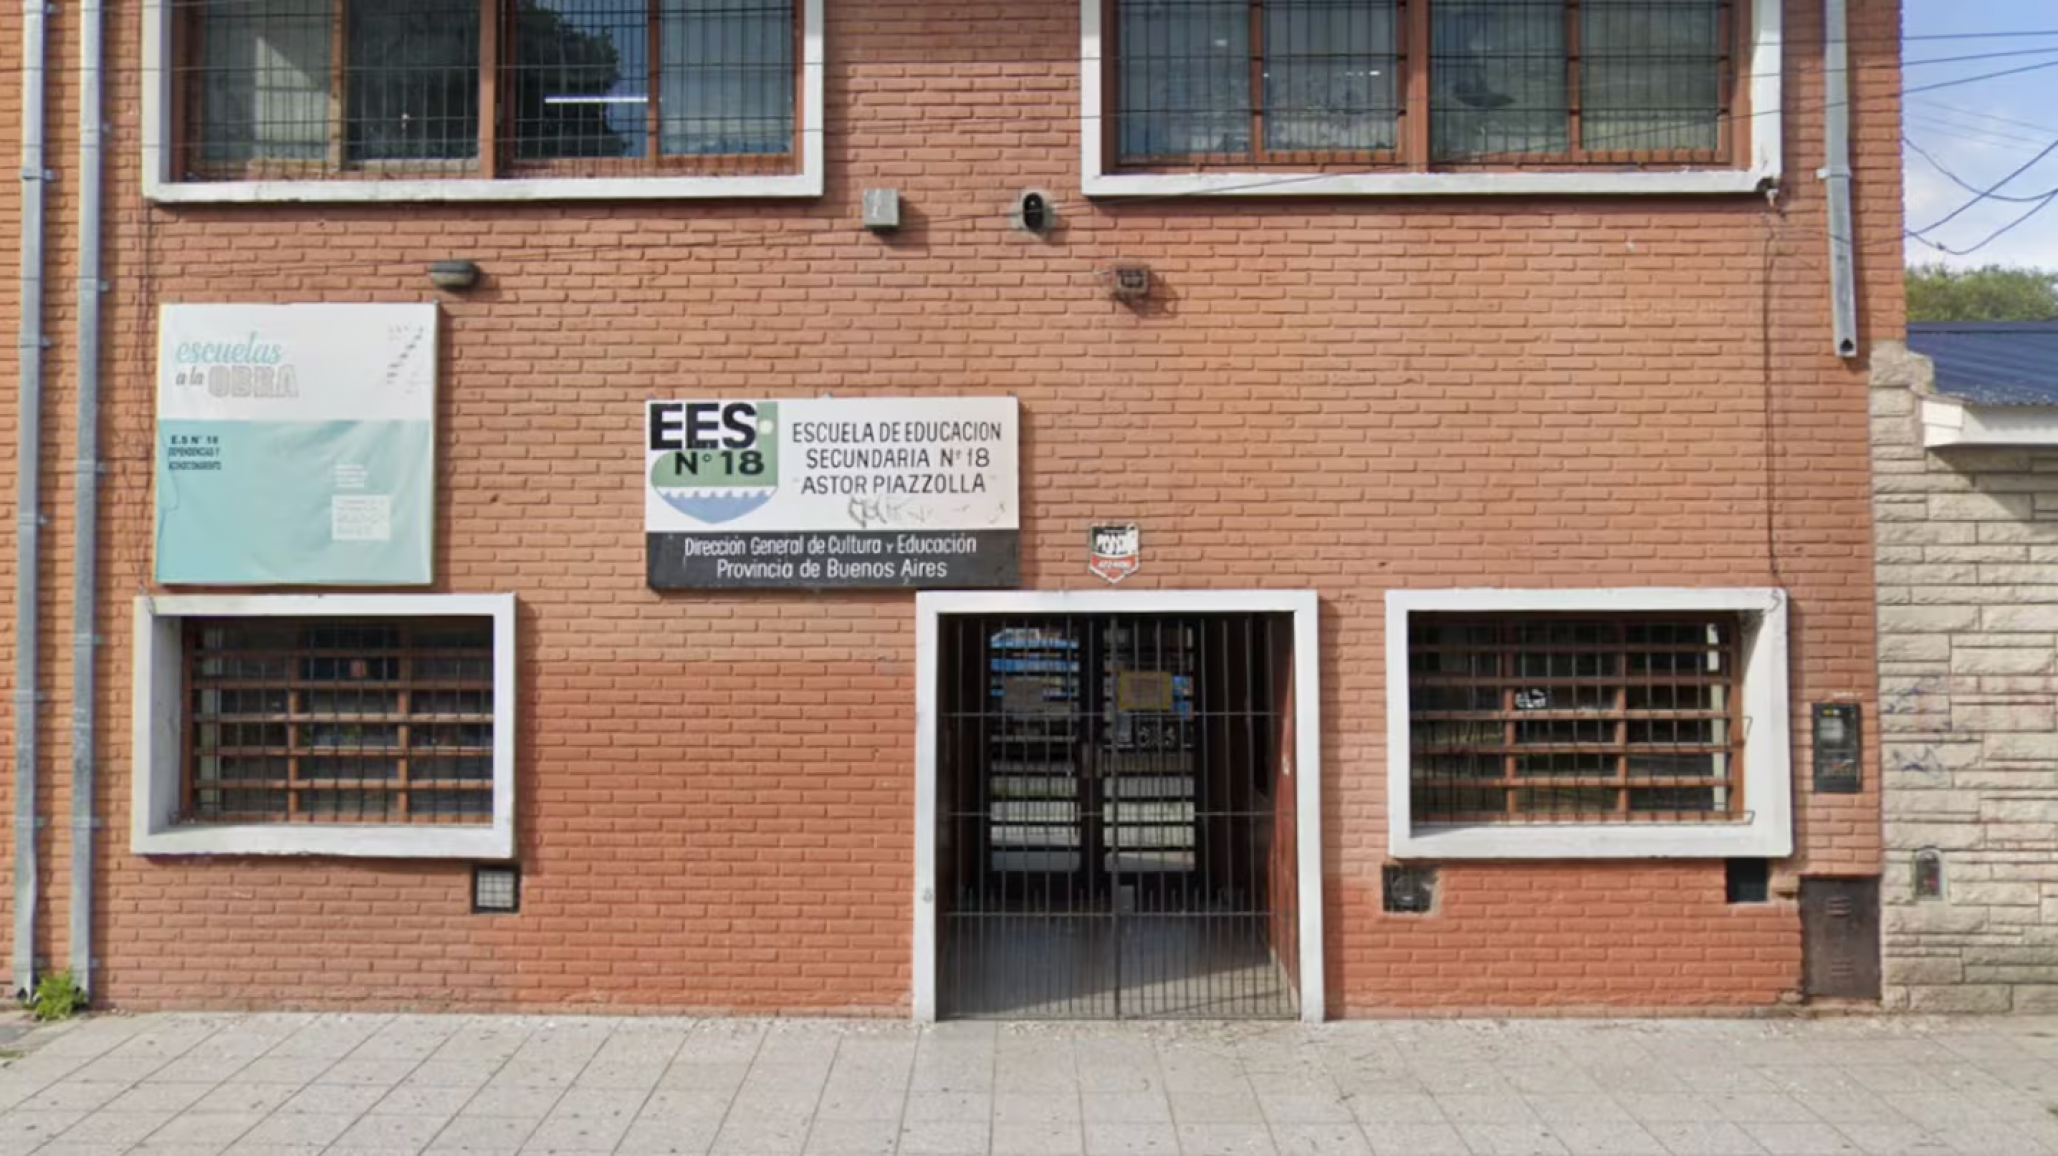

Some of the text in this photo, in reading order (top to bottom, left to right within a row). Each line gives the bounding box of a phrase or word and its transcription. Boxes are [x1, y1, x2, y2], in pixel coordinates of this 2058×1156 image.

[176, 331, 283, 364] escuelas
[175, 364, 299, 398] a la OBRA
[650, 403, 756, 450] EES
[793, 421, 1002, 443] ESCUELA DE EDUCACION
[675, 450, 765, 475] N° 18
[806, 448, 930, 468] SECUNDARIA
[967, 447, 990, 467] 18
[801, 473, 986, 494] ASTOR PIAZZOLLA
[685, 535, 746, 556] Dirección
[751, 536, 803, 555] General
[807, 537, 825, 554] de
[828, 535, 881, 554] Cultura
[897, 533, 977, 554] Educación
[717, 558, 947, 579] Provincia de Buenos Aires
